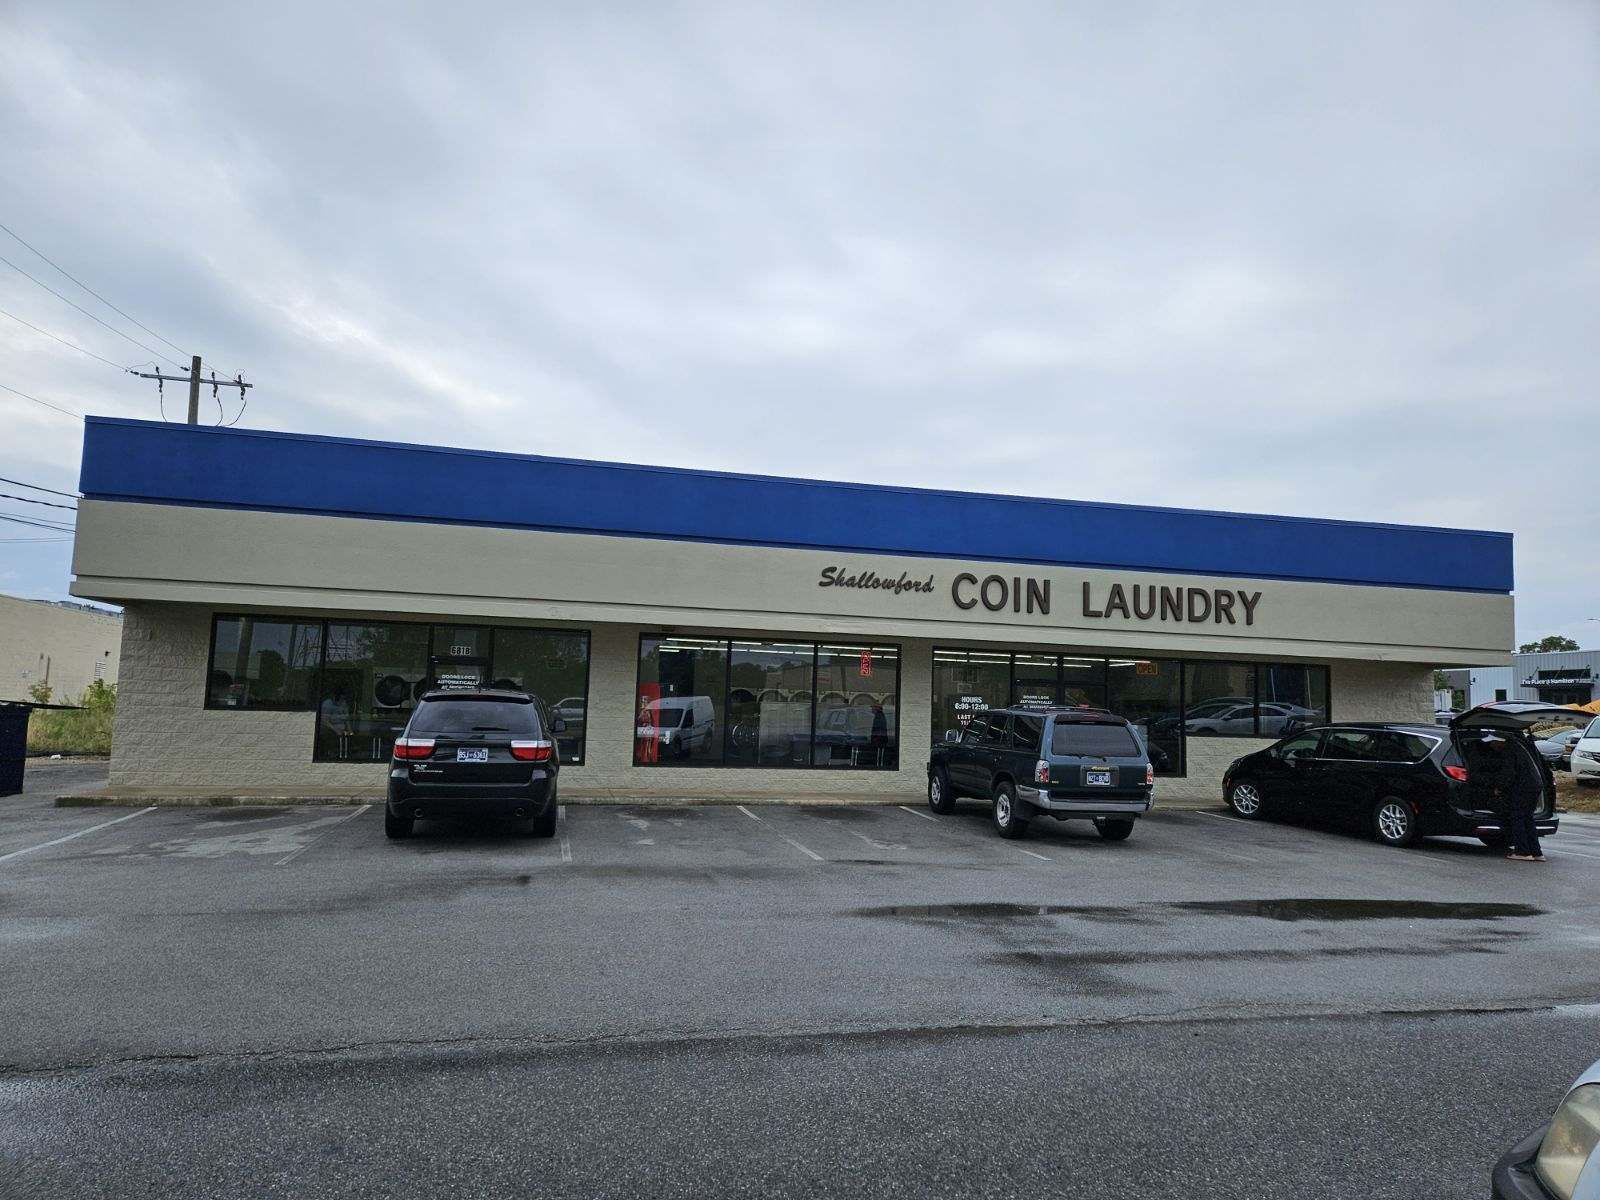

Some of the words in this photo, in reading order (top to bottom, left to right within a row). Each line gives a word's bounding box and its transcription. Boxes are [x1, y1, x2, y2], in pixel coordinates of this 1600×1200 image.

[818, 565, 936, 595] Shallowford
[950, 572, 1051, 615] COIN
[1082, 581, 1263, 626] LAUNDRY
